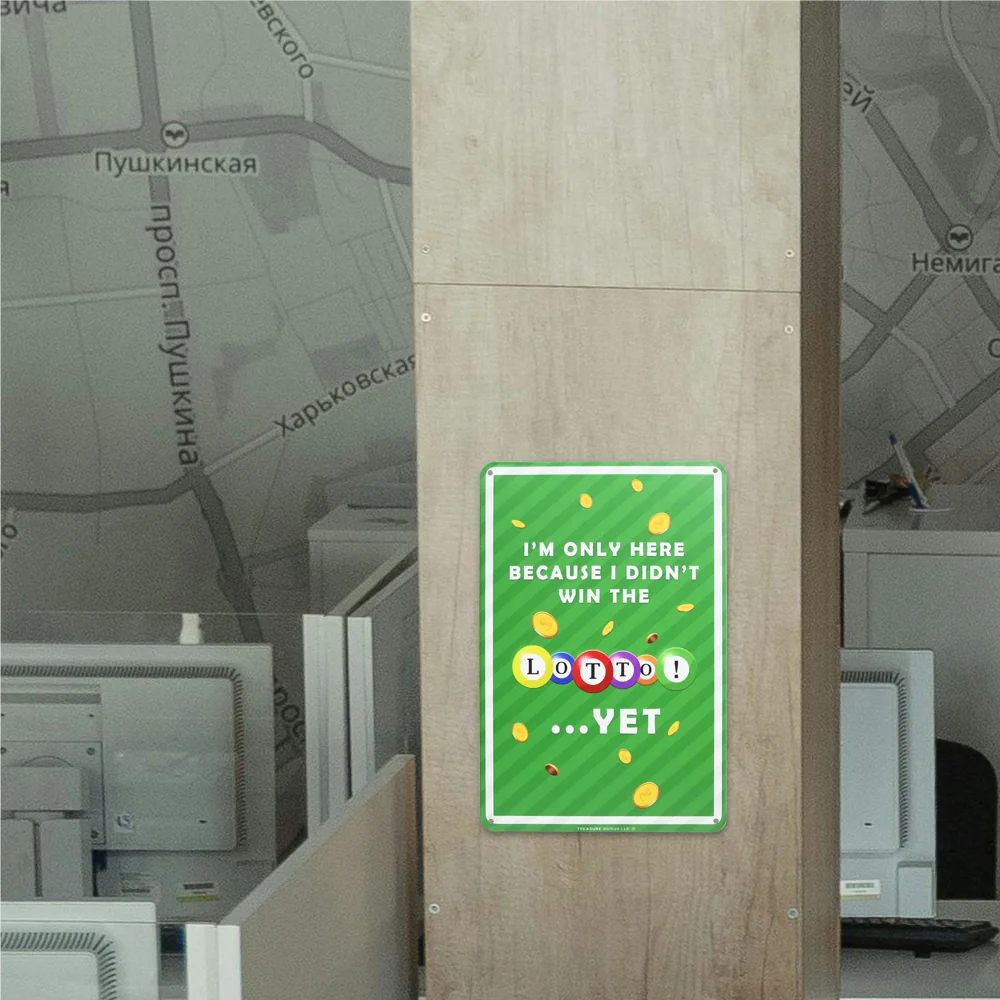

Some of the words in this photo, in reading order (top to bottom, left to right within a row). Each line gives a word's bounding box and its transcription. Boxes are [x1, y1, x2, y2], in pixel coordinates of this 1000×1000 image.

[249, 0, 313, 78] вского
[95, 151, 257, 178] Пушкинская
[145, 205, 180, 309] просп.
[158, 321, 199, 465] Пушкина
[523, 542, 554, 557] I'M
[563, 542, 621, 557] ONLY
[630, 542, 685, 557] HERE
[509, 565, 602, 580] BECAUSE
[610, 565, 617, 580] I
[626, 565, 700, 580] DIDN'T
[558, 589, 600, 604] WIN
[609, 589, 650, 604] THE
